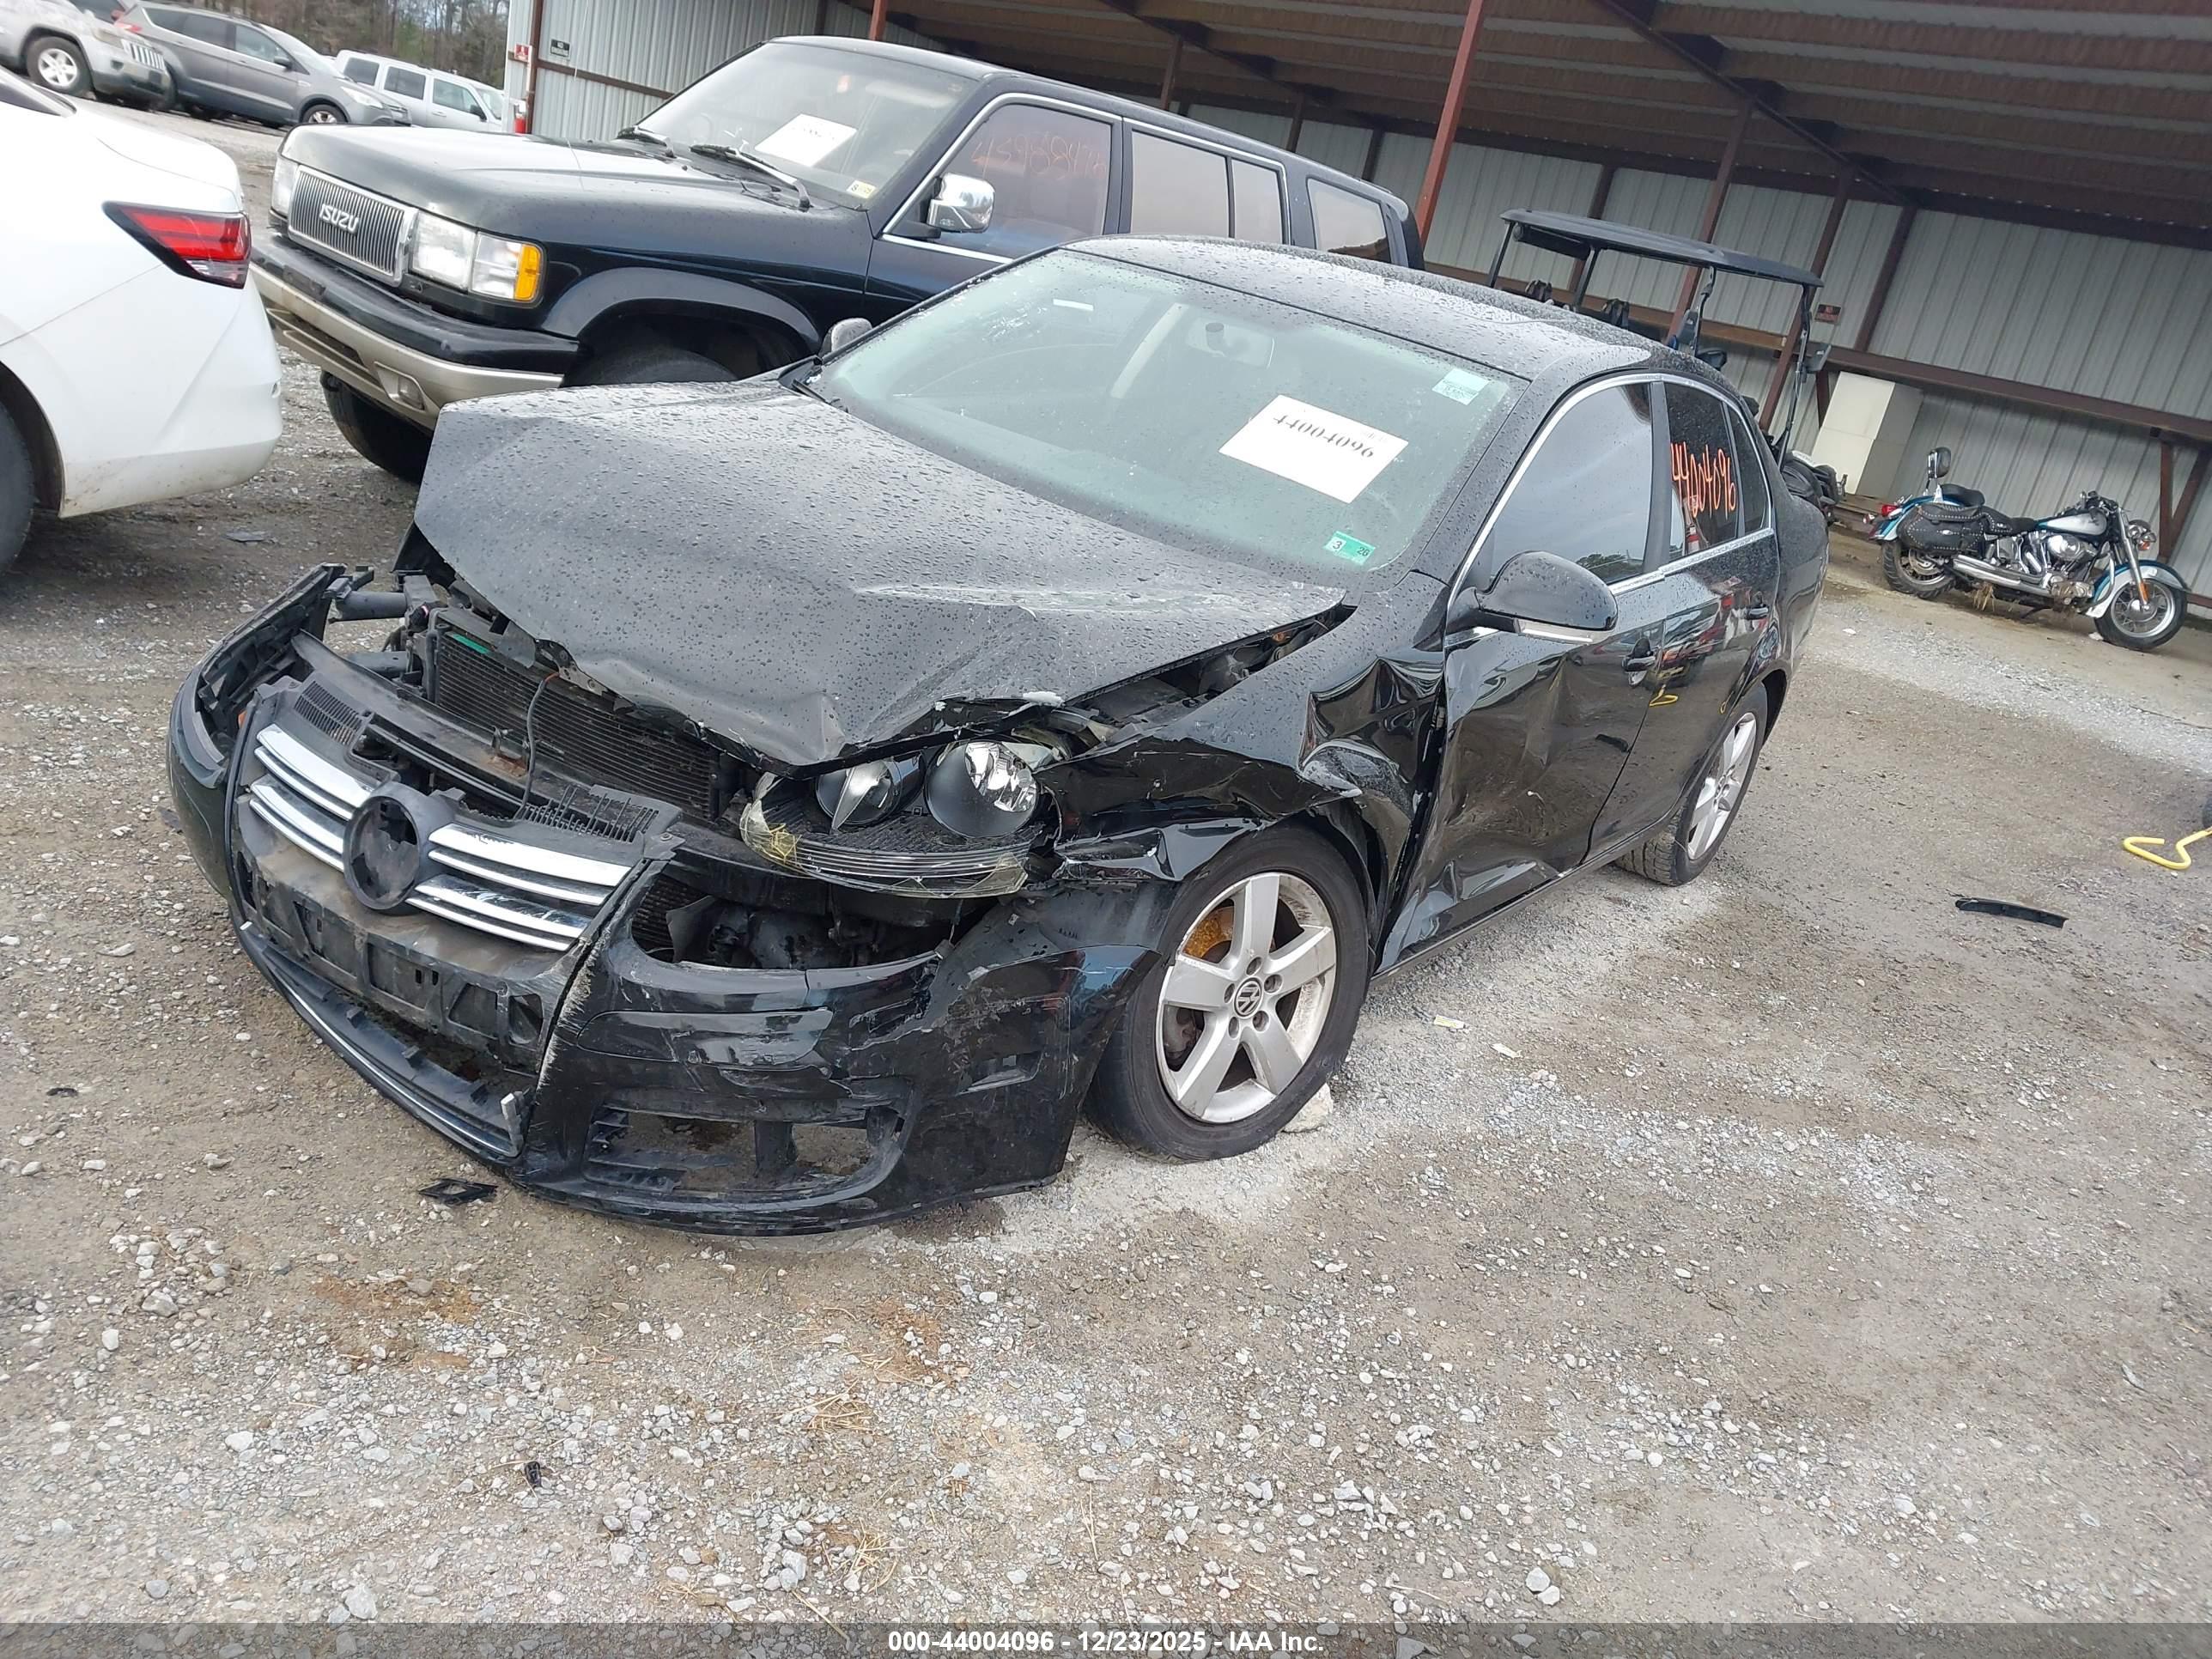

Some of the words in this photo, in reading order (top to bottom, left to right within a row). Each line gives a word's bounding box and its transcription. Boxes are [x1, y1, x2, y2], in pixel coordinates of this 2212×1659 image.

[319, 203, 359, 232] ISUZU
[1273, 414, 1374, 458] 44004096
[1670, 441, 1736, 520] 44004096
[1332, 540, 1343, 550] 3
